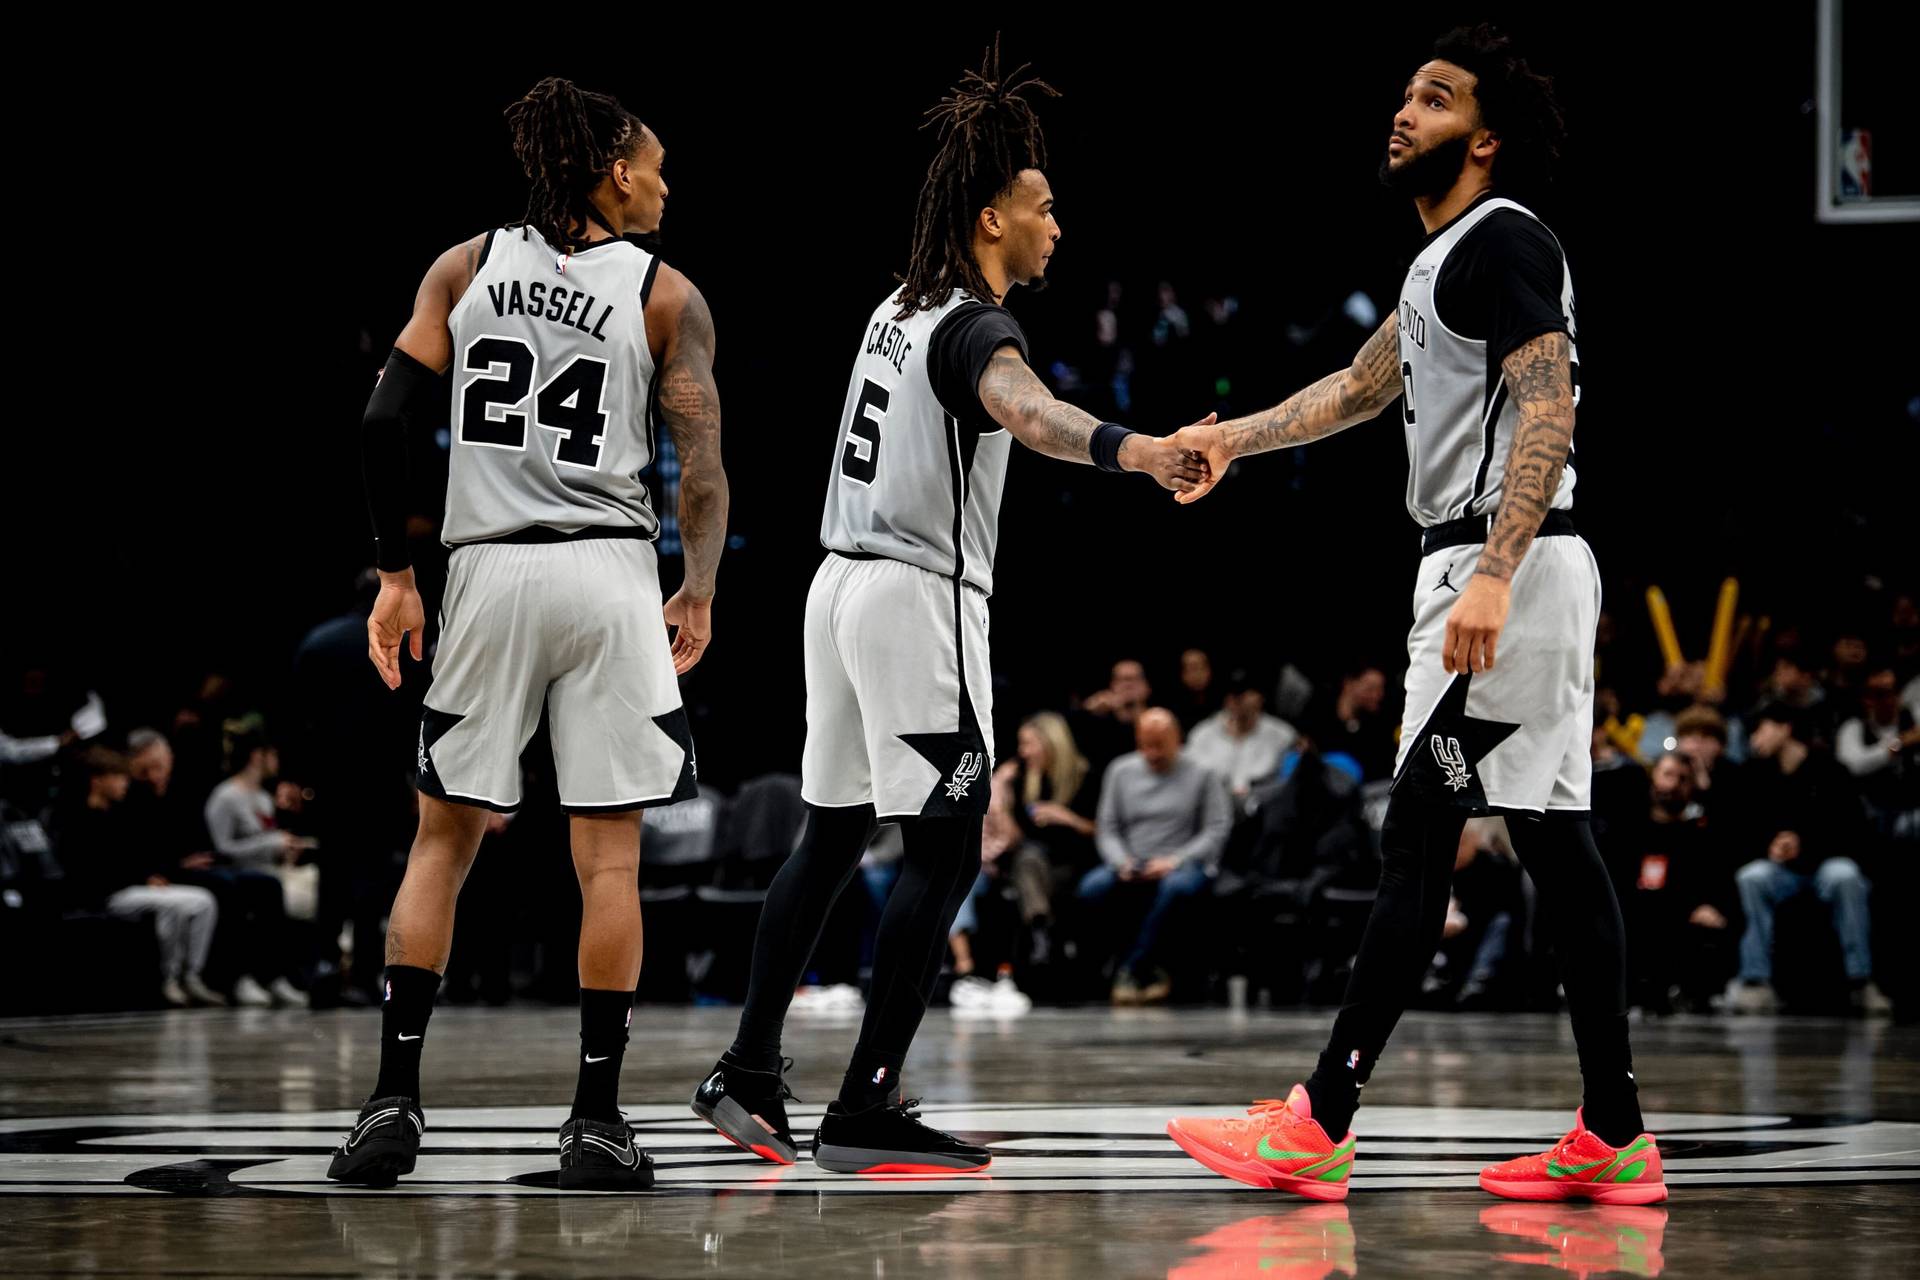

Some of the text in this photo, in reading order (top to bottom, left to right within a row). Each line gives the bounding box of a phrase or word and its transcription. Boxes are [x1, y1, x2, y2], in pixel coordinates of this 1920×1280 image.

[487, 280, 614, 342] VASSELL
[866, 322, 912, 375] CASTLE
[459, 334, 610, 471] 24
[840, 375, 891, 488] 5
